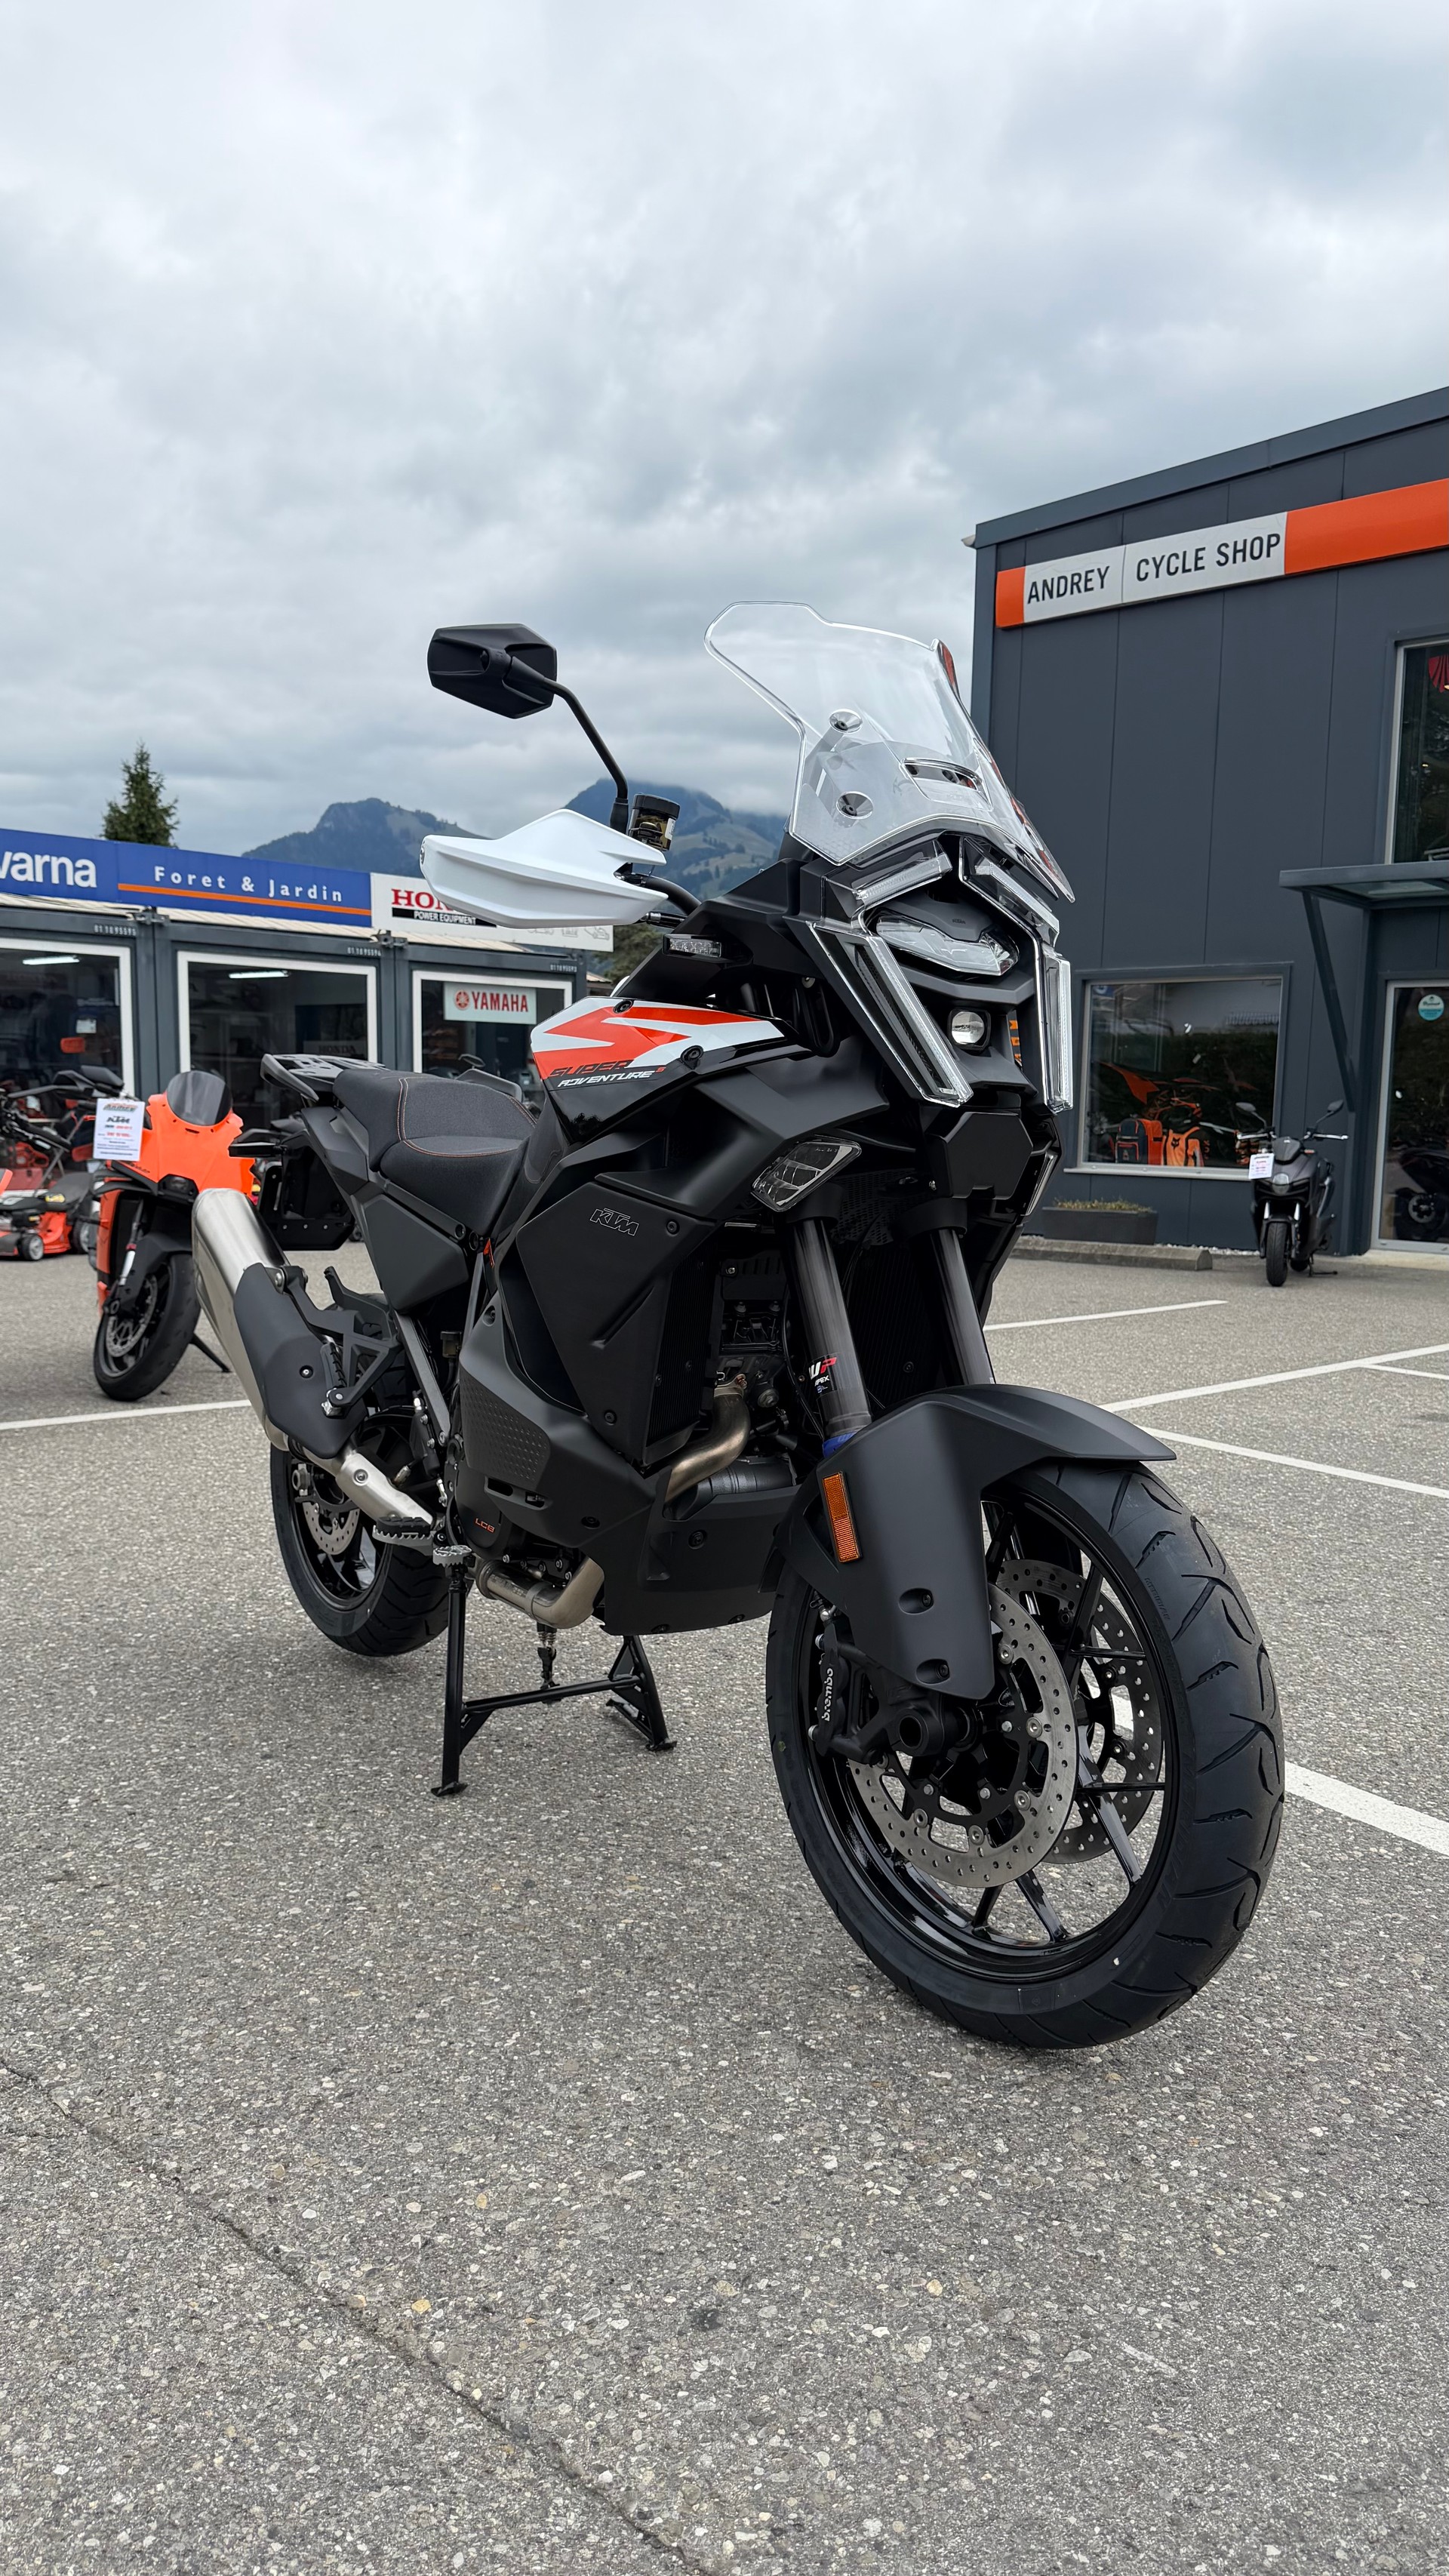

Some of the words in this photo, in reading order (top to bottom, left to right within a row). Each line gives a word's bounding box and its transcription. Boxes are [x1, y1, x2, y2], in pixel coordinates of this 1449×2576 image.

[1027, 566, 1110, 604] ANDREY
[1136, 546, 1206, 582] CYCLE
[1215, 533, 1281, 567] SHOP
[154, 866, 226, 889] Foret
[241, 876, 254, 892] &
[268, 879, 343, 902] Jardin
[414, 910, 438, 921] POWER
[439, 913, 476, 925] EQUIPMENT
[472, 991, 528, 1012] YAMAHA
[548, 1059, 635, 1077] SUPER
[557, 1070, 655, 1087] ADVENTURE
[590, 1208, 639, 1236] KTM
[808, 1357, 837, 1380] WP
[821, 1668, 833, 1722] brembo
